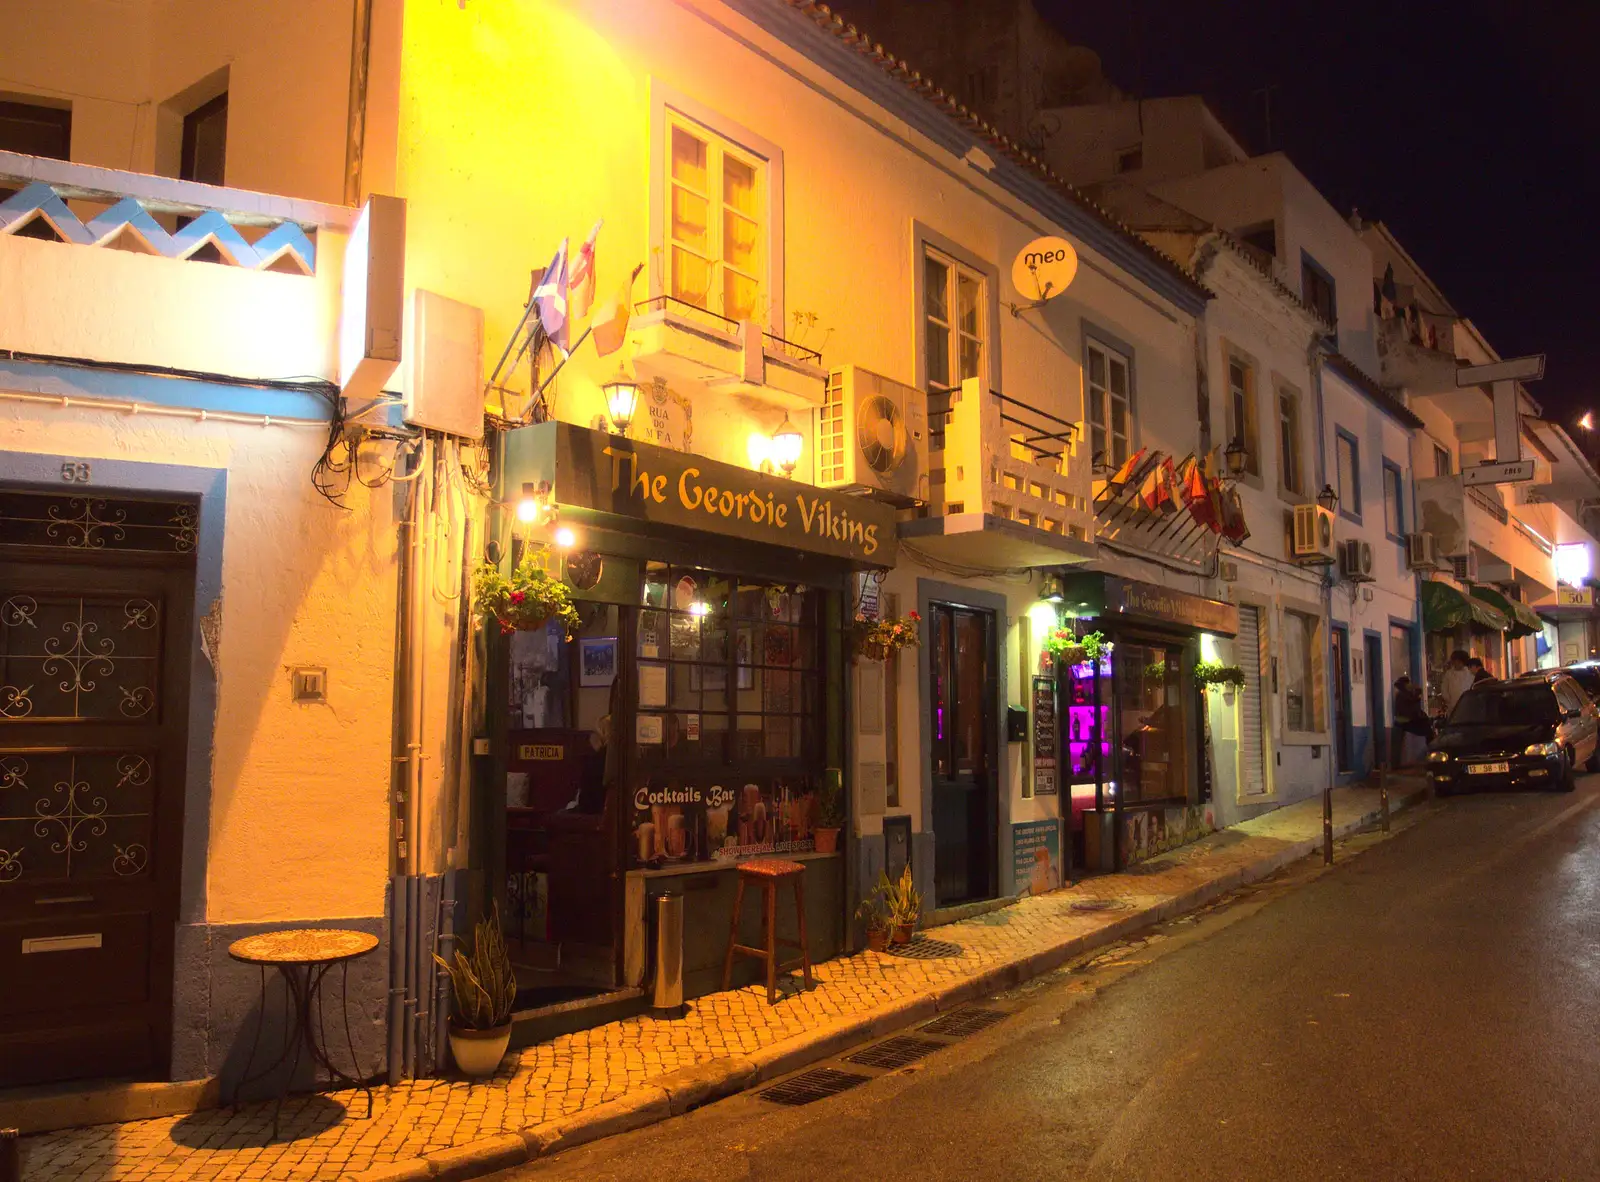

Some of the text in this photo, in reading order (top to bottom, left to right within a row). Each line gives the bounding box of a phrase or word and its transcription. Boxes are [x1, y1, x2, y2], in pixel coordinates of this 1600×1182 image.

[1024, 249, 1066, 265] meo
[649, 405, 669, 421] RUA
[653, 419, 665, 429] DO
[61, 462, 91, 483] 53
[602, 446, 879, 556] The Geordie Viking
[1122, 584, 1140, 609] The
[1568, 591, 1583, 604] 50
[524, 746, 559, 758] PATRICIA
[634, 785, 735, 811] Cocktails Bar
[719, 846, 741, 857] SHOW
